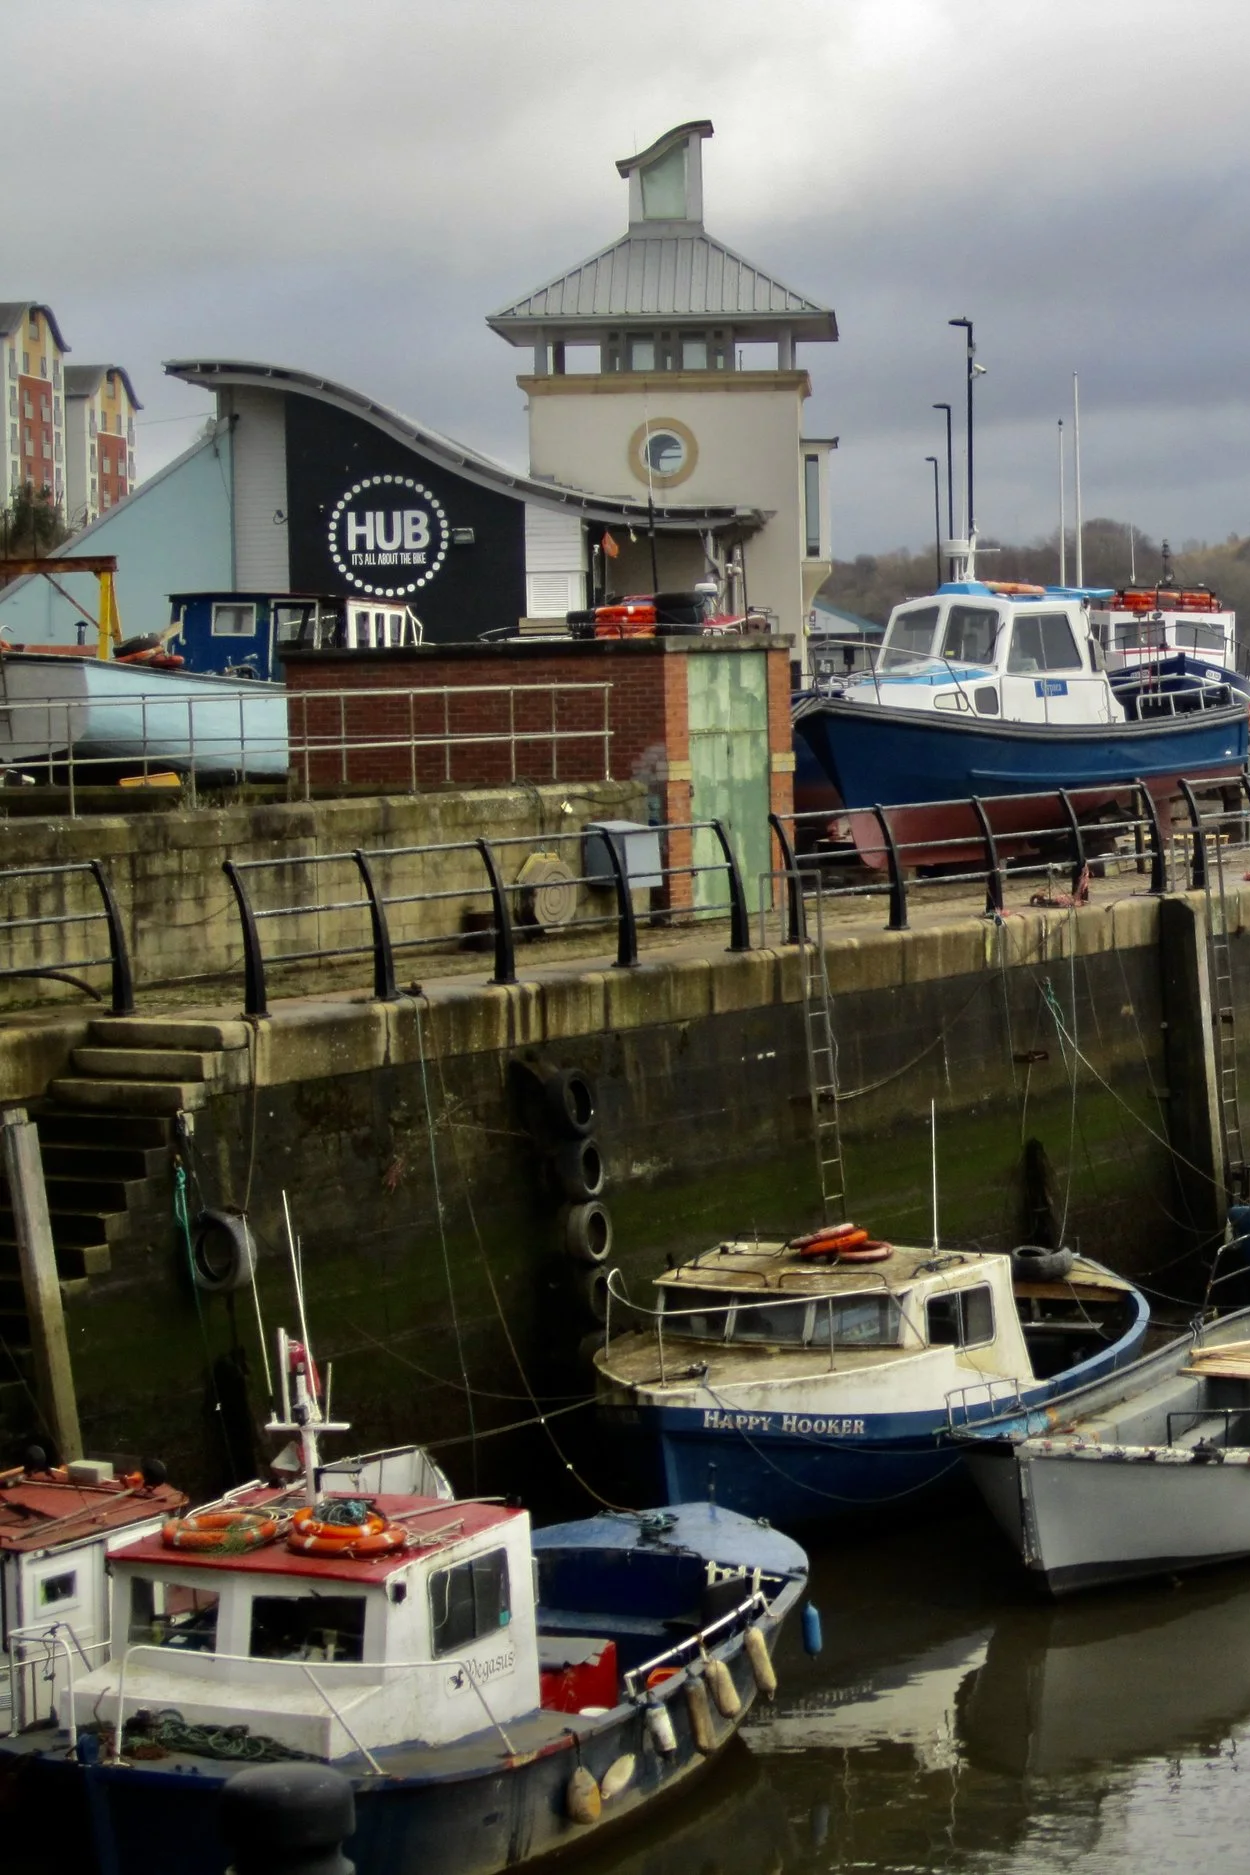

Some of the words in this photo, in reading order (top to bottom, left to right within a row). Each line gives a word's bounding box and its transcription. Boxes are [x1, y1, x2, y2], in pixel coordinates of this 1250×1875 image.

[347, 510, 430, 551] HUB
[351, 553, 363, 566] IT'S
[364, 553, 376, 565] ALL
[377, 552, 398, 565] ABOUT
[400, 552, 412, 565] THE
[412, 552, 426, 564] BIKE
[703, 1410, 772, 1431] HAPPY
[781, 1414, 865, 1435] HOOKER
